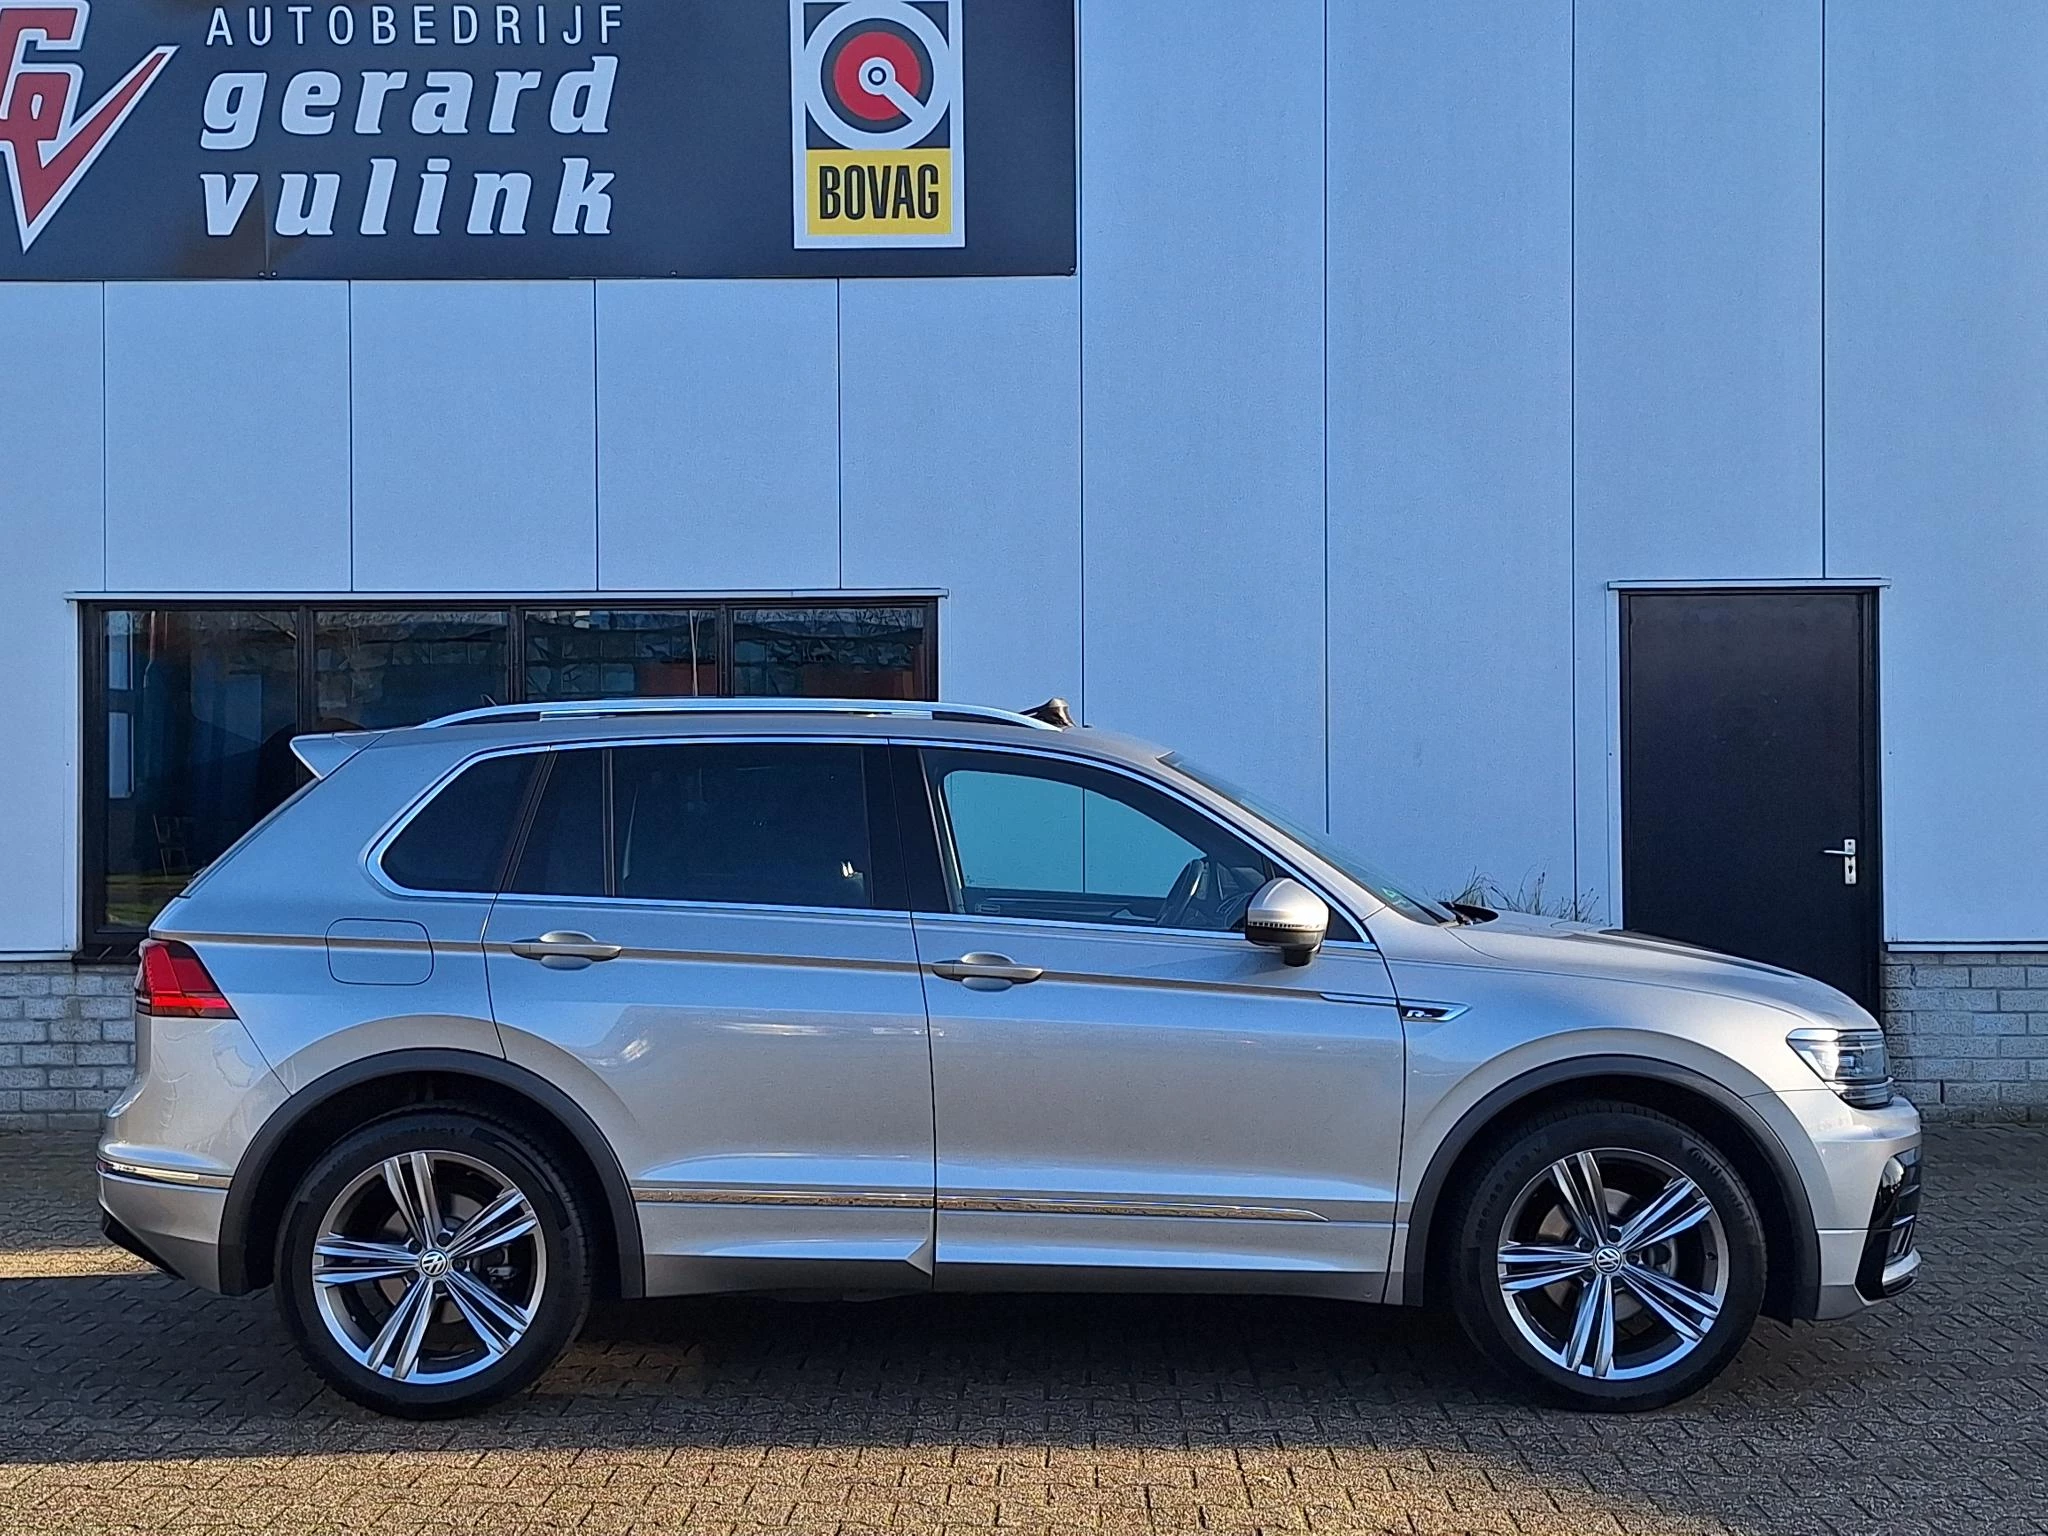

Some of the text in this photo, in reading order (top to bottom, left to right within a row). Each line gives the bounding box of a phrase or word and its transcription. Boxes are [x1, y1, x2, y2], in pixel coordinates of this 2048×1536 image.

[207, 6, 620, 45] AUTOBEDRIJF
[201, 56, 618, 149] gerard
[200, 158, 614, 235] vulink
[820, 164, 938, 220] BOVAG
